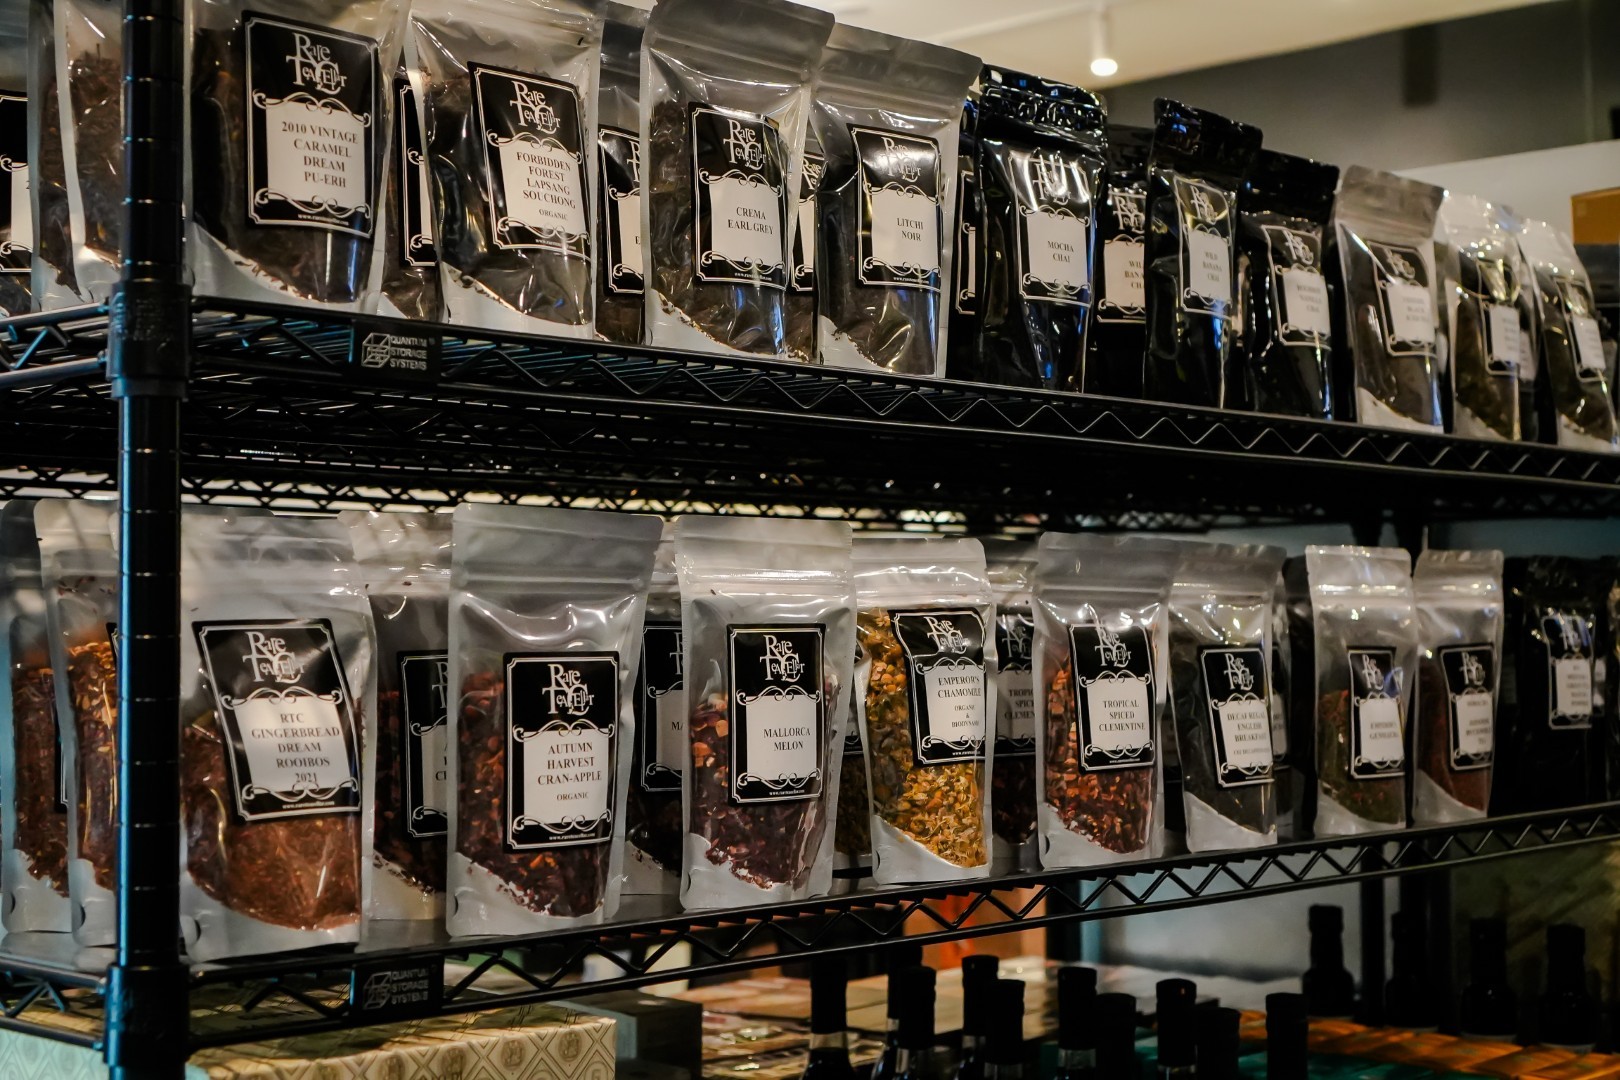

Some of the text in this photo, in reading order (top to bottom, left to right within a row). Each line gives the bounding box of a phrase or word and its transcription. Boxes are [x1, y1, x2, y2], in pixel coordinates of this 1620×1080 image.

[281, 121, 359, 144] 2010 VINTAGE
[293, 138, 352, 158] CARAMEL
[303, 155, 346, 172] DREAM
[516, 152, 571, 171] FORBIDDEN
[304, 171, 346, 188] PU-ERH
[528, 166, 565, 182] FOREST
[526, 178, 570, 195] LAPSANG
[522, 190, 576, 209] SOUCHONG
[538, 209, 568, 220] ORGANIC
[736, 206, 766, 220] CREMA
[727, 219, 774, 235] EARL GREY
[897, 218, 924, 230] LITCHI
[901, 230, 922, 241] NOIR
[1047, 240, 1074, 253] MOCHA
[390, 335, 427, 347] QUANTUM
[390, 347, 427, 359] STORAGE
[389, 359, 427, 371] SYSTEMS
[938, 676, 980, 686] EMPEROR'S
[1103, 700, 1139, 708] TROPICAL
[280, 713, 304, 724] RTC
[1110, 711, 1135, 719] SPICED
[251, 726, 340, 739] GINGERBREAD
[764, 727, 811, 738] MALLORCA
[1099, 723, 1145, 731] CLEMENTINE
[278, 742, 321, 753] DREAM
[548, 742, 593, 755] AUTUMN
[774, 740, 804, 751] MELON
[276, 757, 330, 769] ROOIBOS
[547, 757, 594, 770] HARVEST
[295, 772, 317, 783] 2021
[537, 770, 602, 785] CRAN-APPLE
[557, 791, 589, 801] ORGANIC
